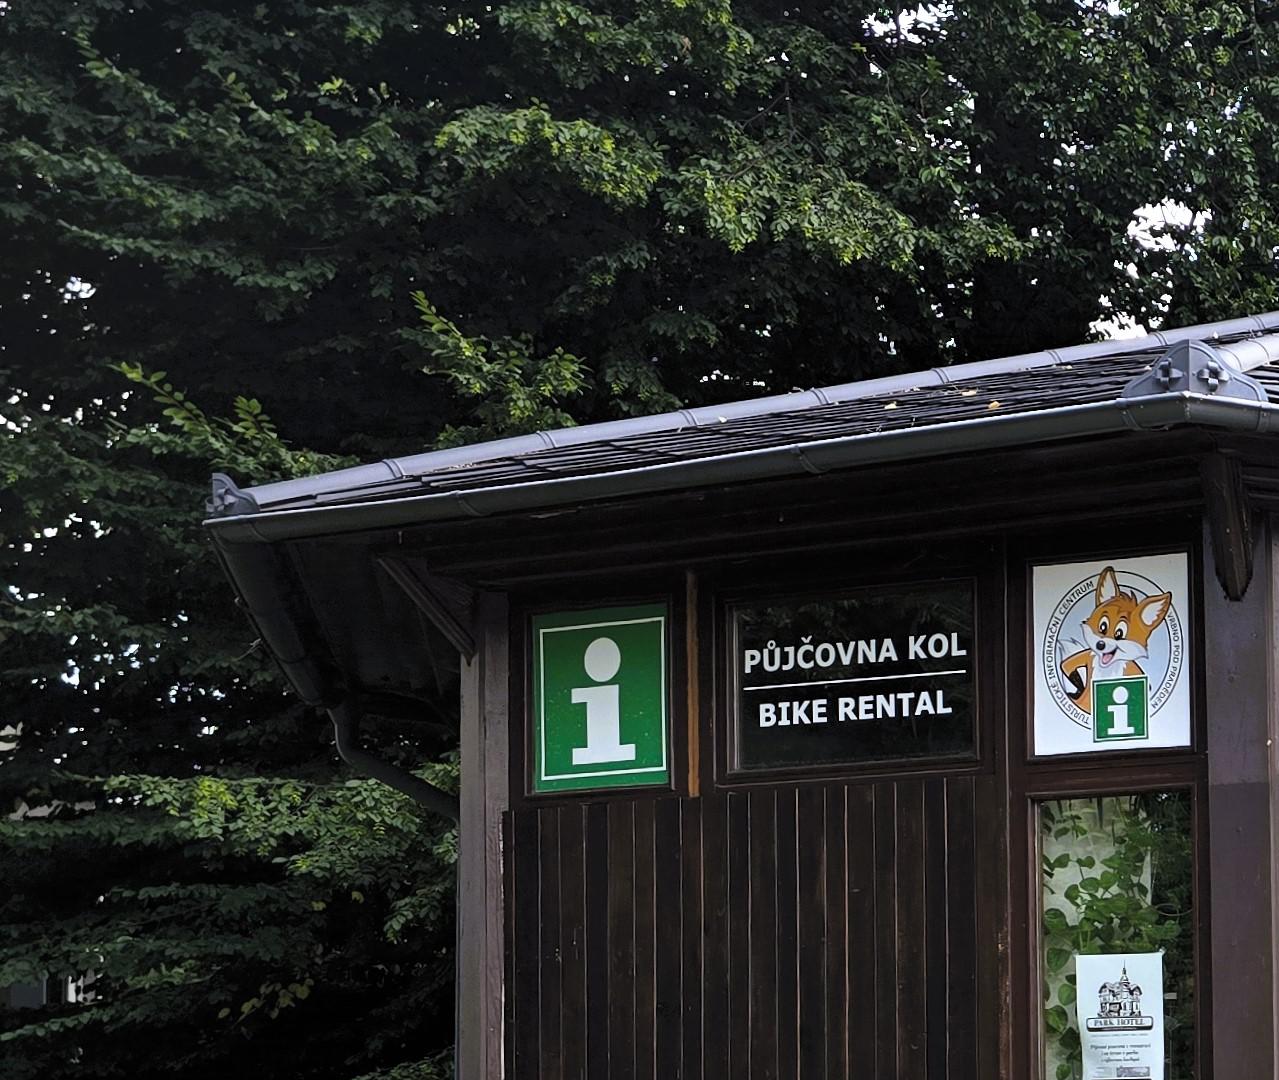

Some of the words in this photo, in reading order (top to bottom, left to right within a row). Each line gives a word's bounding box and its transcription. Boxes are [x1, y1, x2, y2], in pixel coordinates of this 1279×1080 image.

[1058, 580, 1095, 615] CENTRUM
[1168, 612, 1180, 643] VRBNO
[744, 635, 898, 674] PŮJČOVNA
[908, 632, 967, 660] KOL
[1045, 616, 1061, 680] INFORMAČNÍ
[759, 698, 828, 728] BIKE
[838, 689, 953, 722] RENTAL
[1049, 680, 1090, 725] TURISTICKÉ
[1094, 1018, 1115, 1027] PARK
[1116, 1017, 1145, 1026] HOTEL
